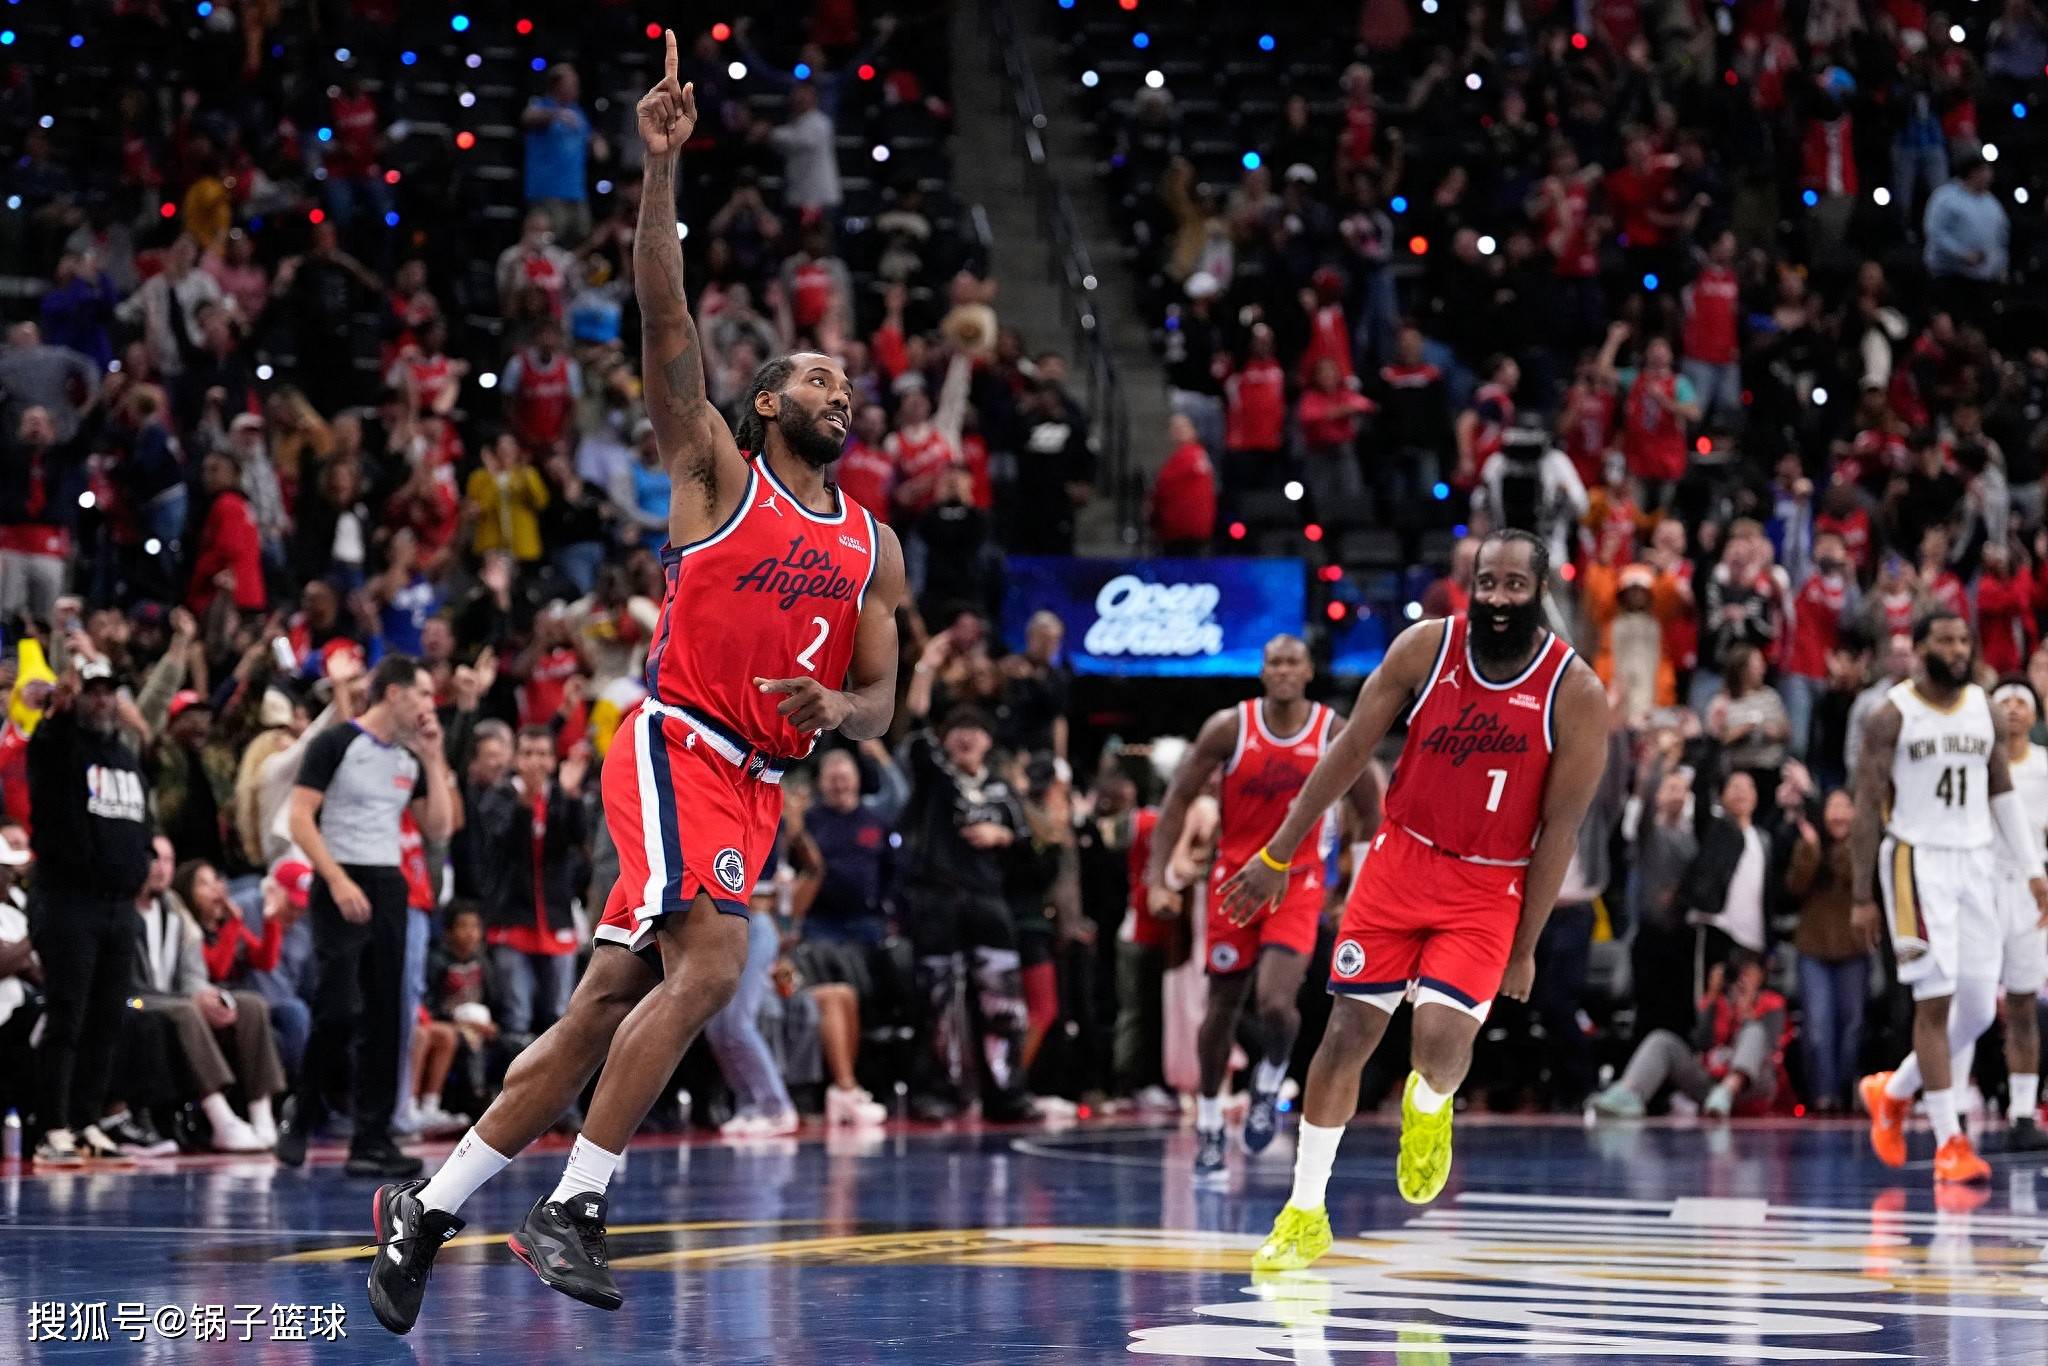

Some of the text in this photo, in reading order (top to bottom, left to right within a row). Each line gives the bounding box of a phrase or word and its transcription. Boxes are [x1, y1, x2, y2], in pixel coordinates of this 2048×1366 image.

[781, 535, 832, 570] Los
[733, 557, 857, 611] Angeles
[796, 616, 830, 672] 2
[1454, 702, 1500, 733] Los
[1422, 724, 1529, 768] Angeles
[1486, 769, 1508, 812] 1
[1935, 765, 1967, 807] 41
